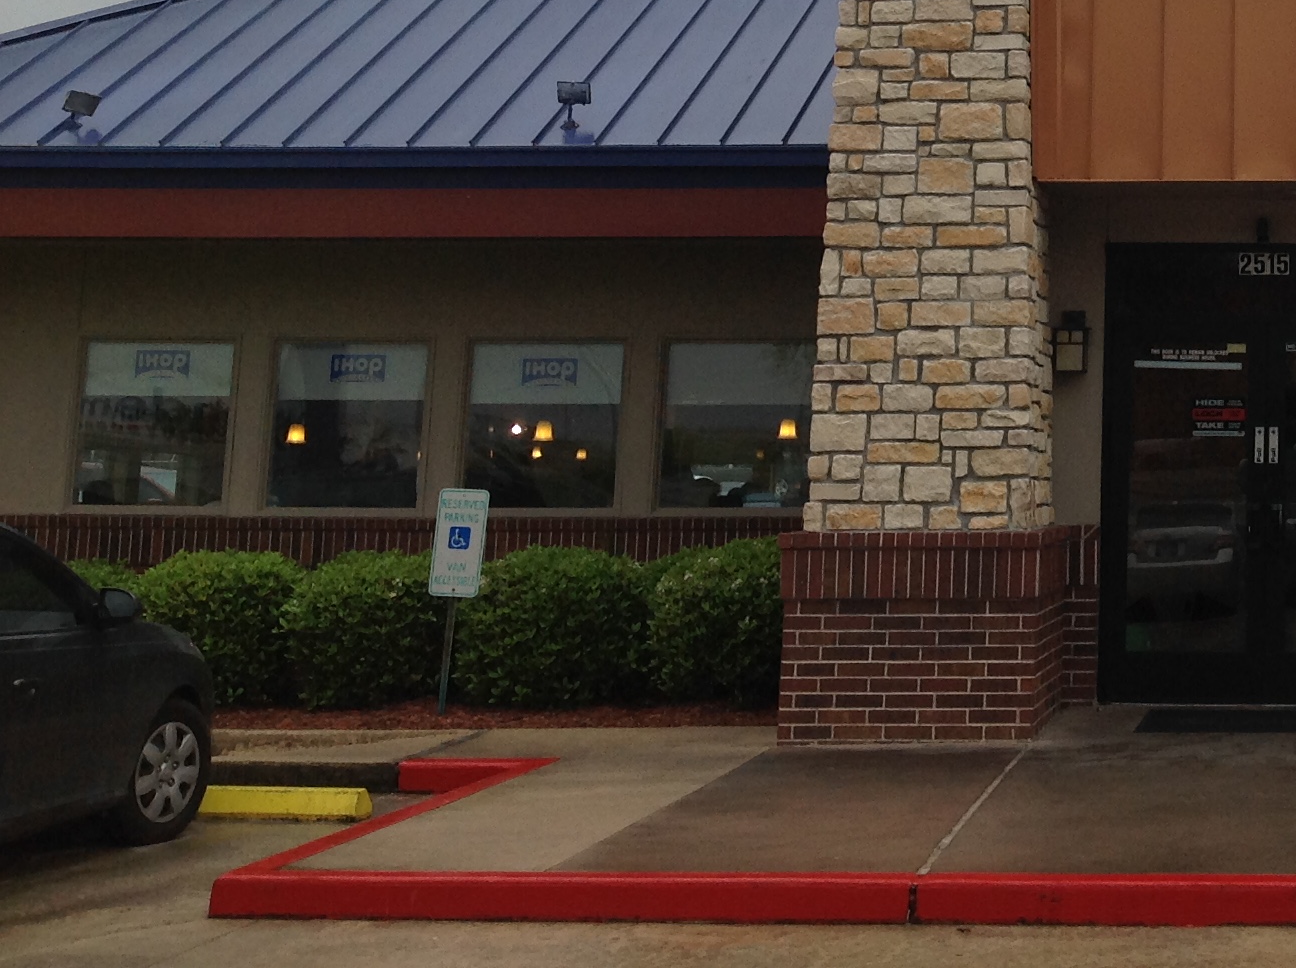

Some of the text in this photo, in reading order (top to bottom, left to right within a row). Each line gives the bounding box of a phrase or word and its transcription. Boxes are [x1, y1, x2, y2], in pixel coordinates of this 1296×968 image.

[1240, 254, 1288, 274] 2515
[138, 353, 187, 372] IHOP
[333, 358, 383, 375] IHOP
[525, 361, 575, 380] IHOP
[441, 498, 486, 510] RESERVED
[444, 512, 479, 523] PARKING
[446, 562, 467, 571] VAN
